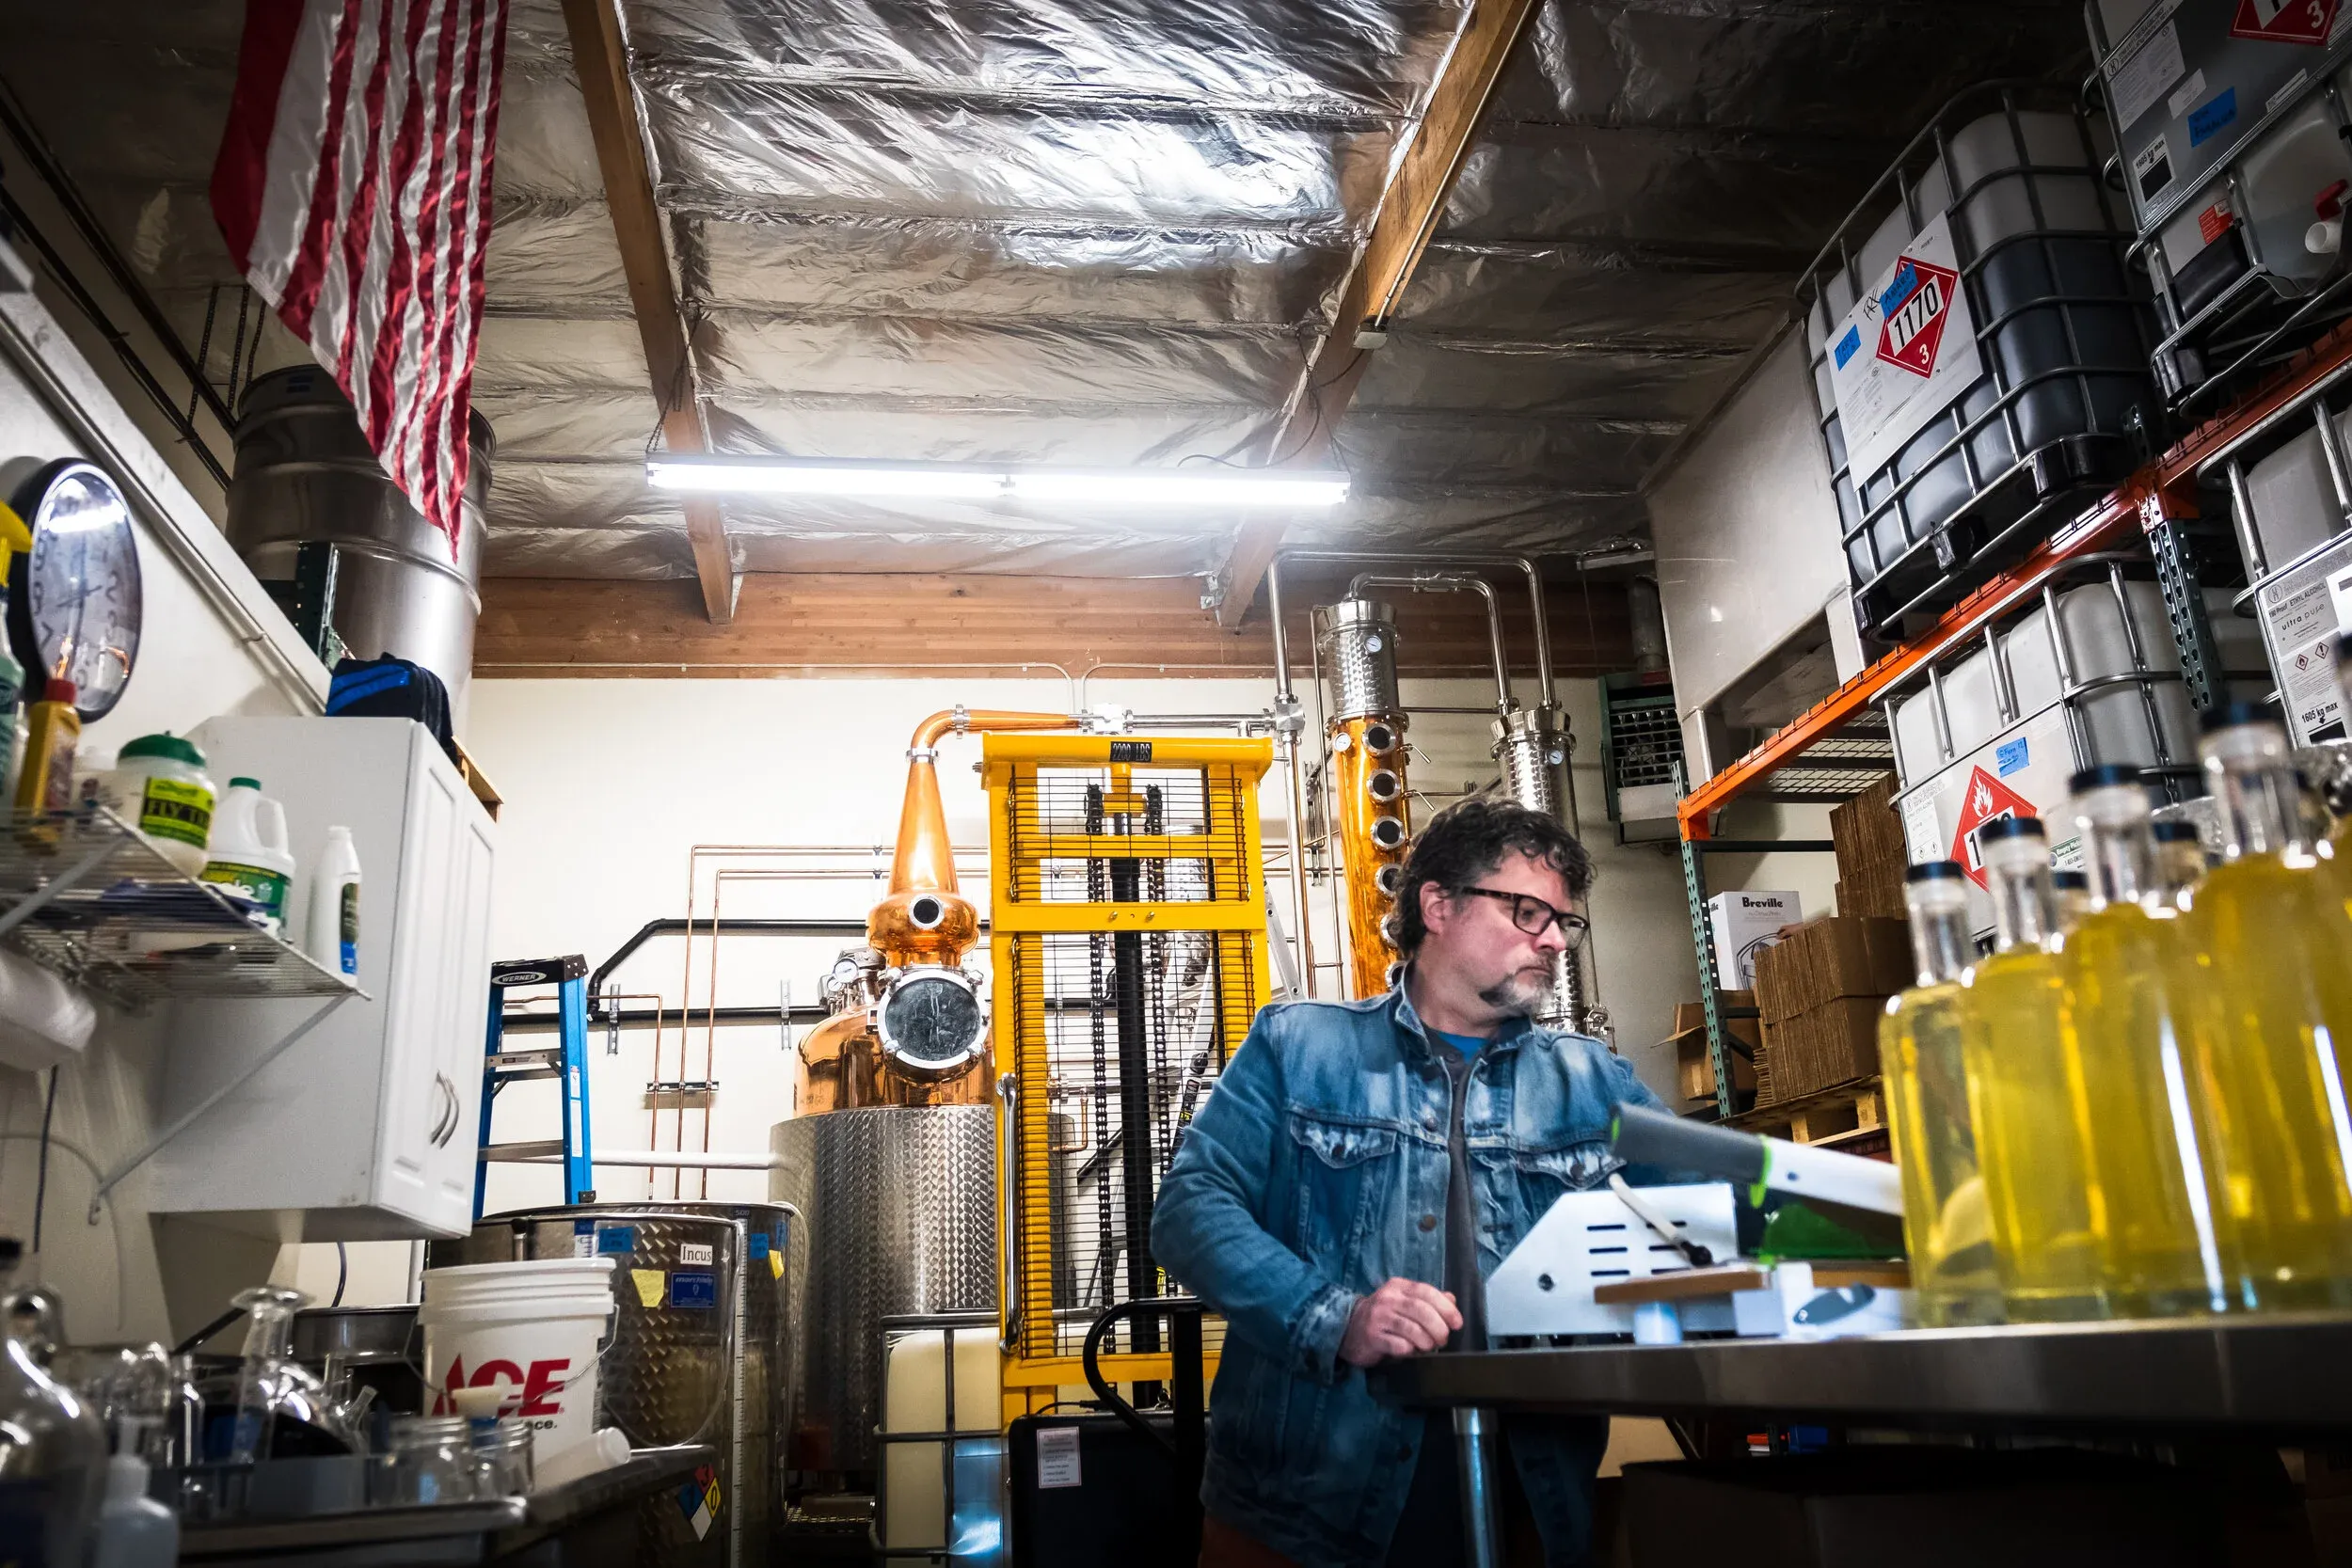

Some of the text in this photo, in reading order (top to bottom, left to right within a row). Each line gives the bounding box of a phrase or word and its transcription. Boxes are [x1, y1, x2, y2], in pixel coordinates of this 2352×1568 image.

[2307, 0, 2325, 28] 3
[1894, 282, 1939, 348] 1170
[1919, 343, 1930, 365] 3
[2289, 595, 2305, 607] ETHYL
[2304, 583, 2327, 598] ALCOHOL
[2281, 603, 2325, 631] ultra pure
[2301, 702, 2339, 723] 1605 kg max
[1136, 743, 1150, 761] LBS
[148, 799, 183, 819] FLY
[1741, 896, 1784, 908] Breville
[502, 974, 535, 982] WERNER
[682, 1245, 712, 1262] Incus
[431, 1354, 571, 1417] ACE
[710, 1485, 718, 1511] 0
